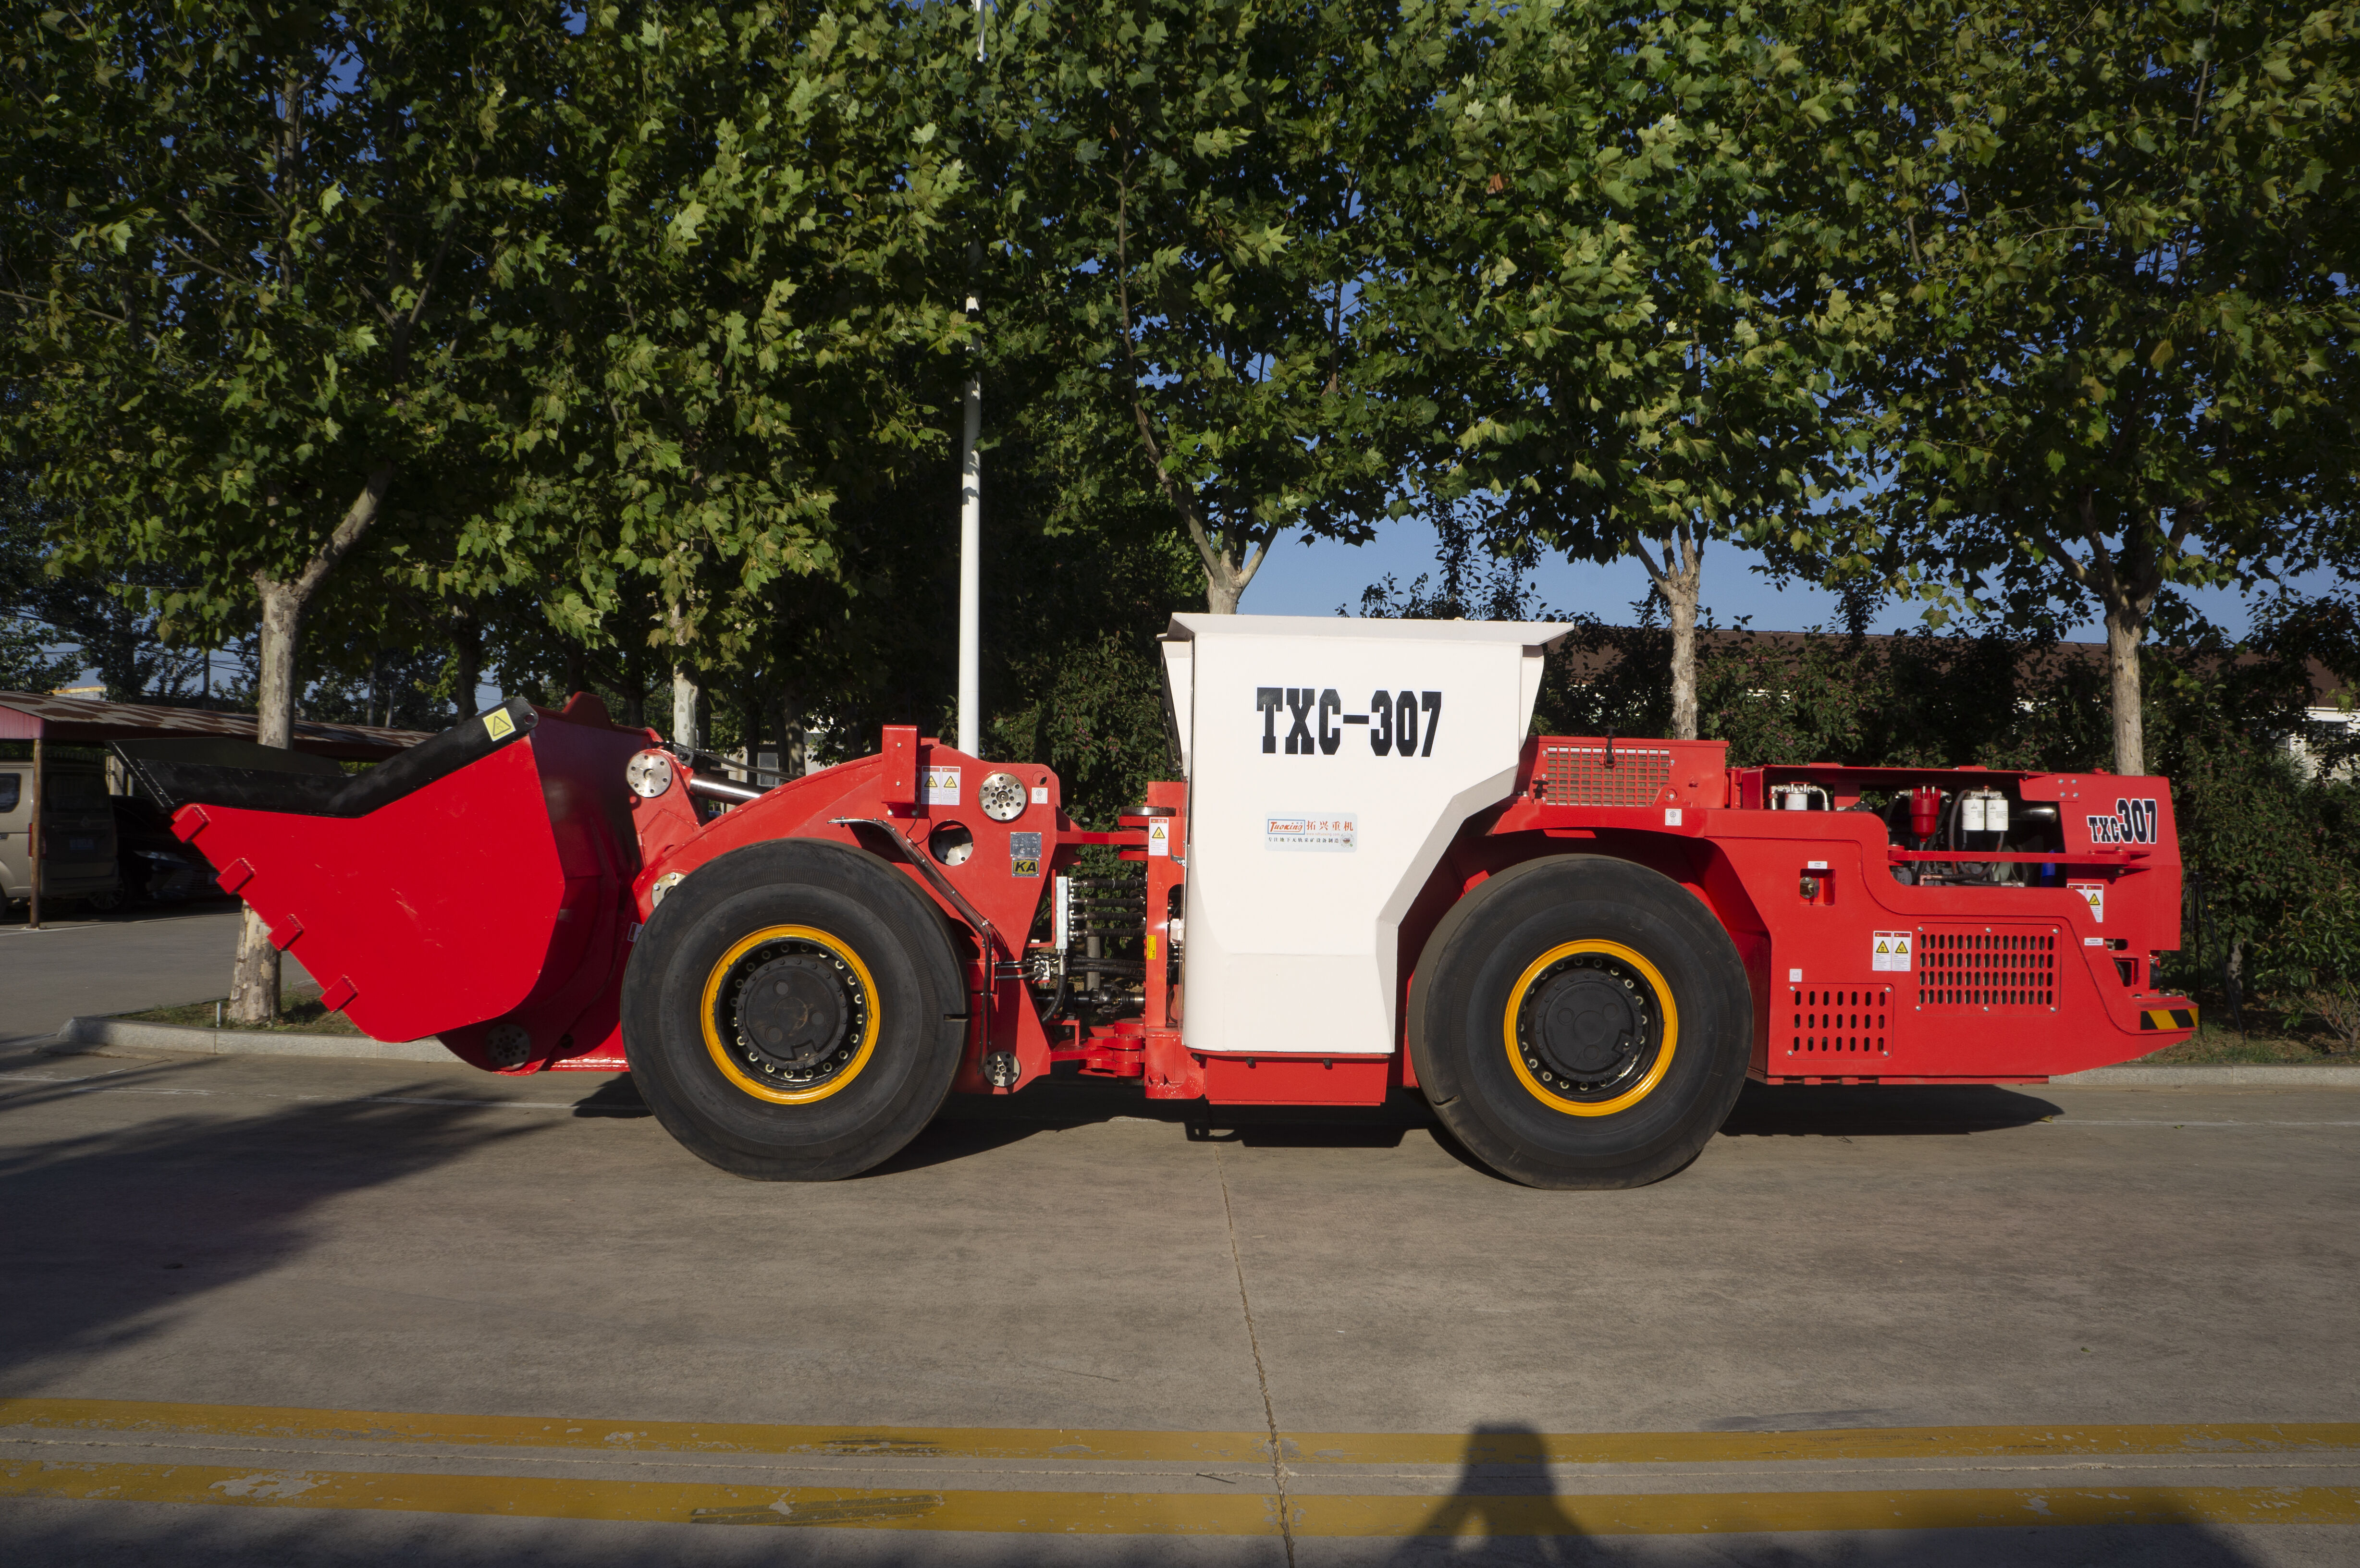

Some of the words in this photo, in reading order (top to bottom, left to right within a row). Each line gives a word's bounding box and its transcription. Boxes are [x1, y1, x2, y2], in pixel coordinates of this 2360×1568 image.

[1257, 687, 1441, 757] TXC-307
[1270, 821, 1303, 833] Tuoxing
[1306, 820, 1353, 831] 拓兴重机
[2087, 798, 2157, 844] TXC307
[1015, 862, 1037, 872] KA
